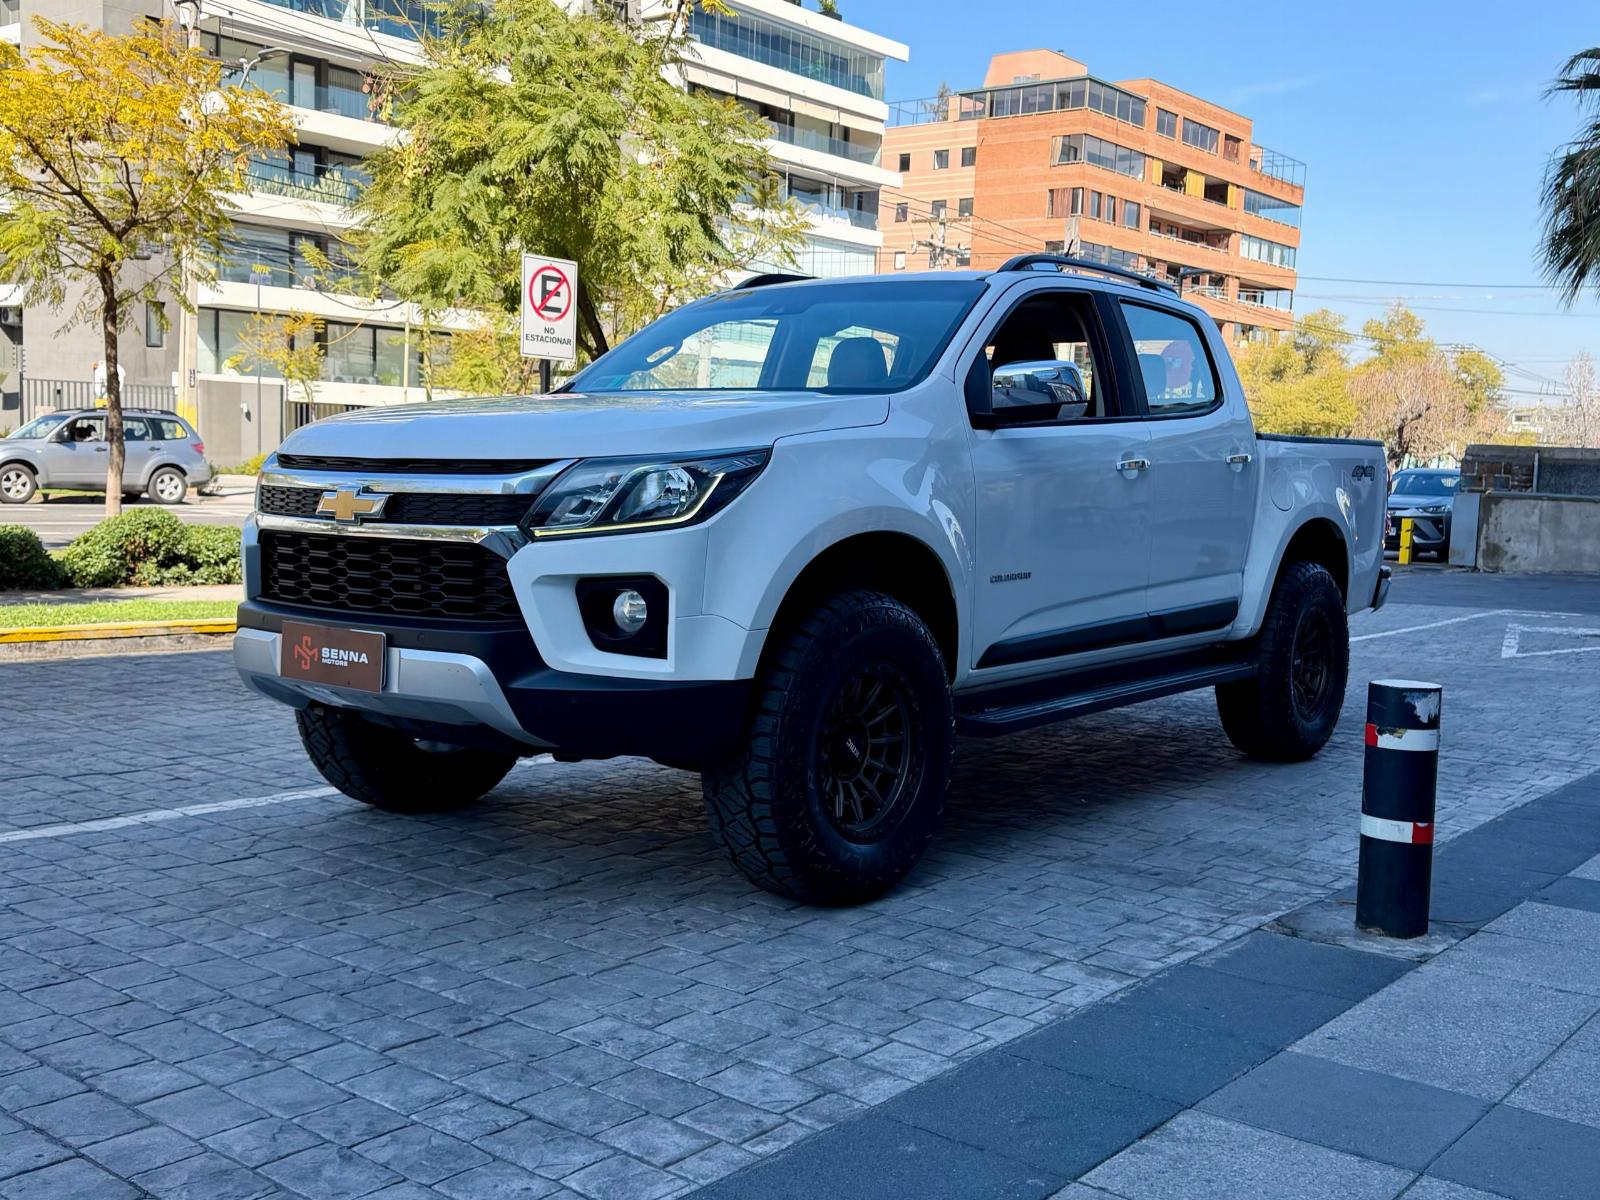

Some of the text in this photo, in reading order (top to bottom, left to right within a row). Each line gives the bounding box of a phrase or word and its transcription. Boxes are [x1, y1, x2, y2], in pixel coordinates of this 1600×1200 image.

[544, 326, 556, 335] NO
[525, 333, 572, 346] ESTACIONAR
[321, 647, 369, 664] SENNA
[321, 658, 348, 667] MOTORS
